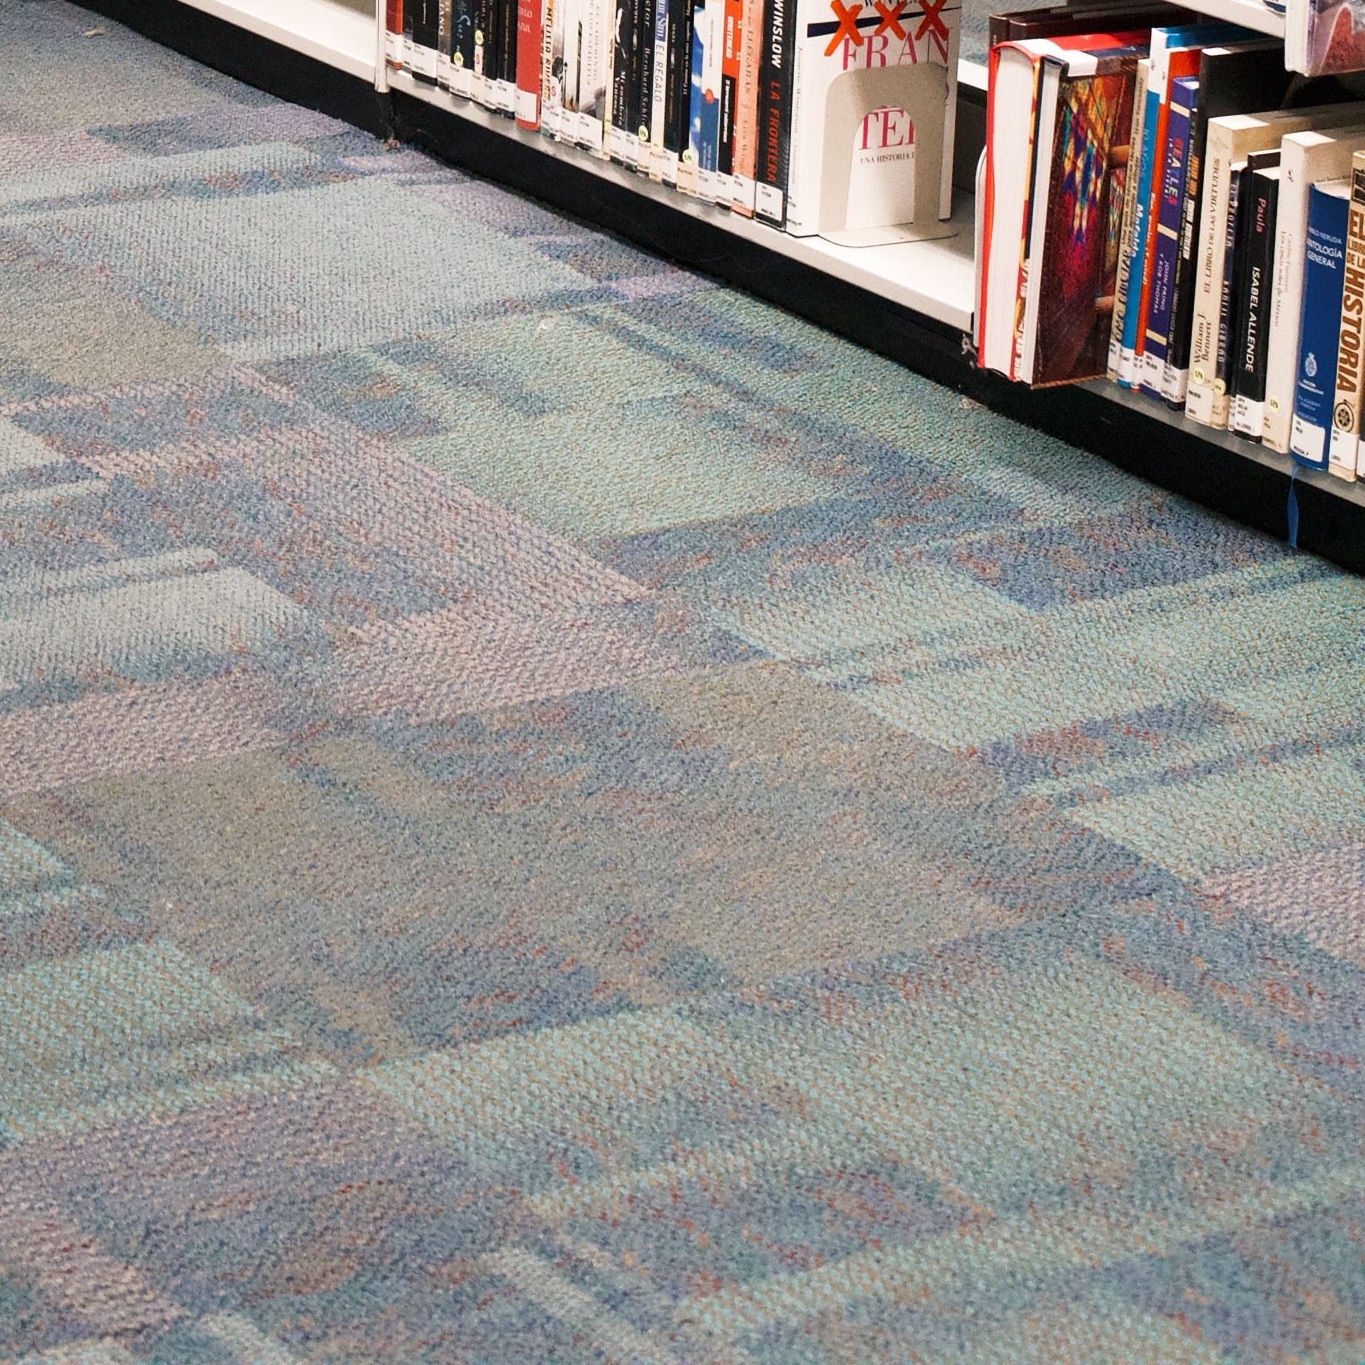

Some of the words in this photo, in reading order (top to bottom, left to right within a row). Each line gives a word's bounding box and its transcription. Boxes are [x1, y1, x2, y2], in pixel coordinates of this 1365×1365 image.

[655, 44, 665, 57] EL
[654, 59, 664, 103] REGALO
[770, 81, 780, 99] LA
[766, 107, 780, 183] FRONTERA
[875, 152, 911, 164] HISTORIA
[1167, 137, 1183, 205] BEATLES
[1209, 158, 1220, 215] VIRTUDES
[1130, 203, 1144, 258] Mafalda
[1255, 197, 1267, 233] Paula
[1249, 266, 1261, 308] ISABEL
[1194, 324, 1204, 364] William
[1202, 322, 1212, 361] Bennett
[1244, 311, 1259, 373] ALLENDE
[1336, 269, 1364, 392] HISTORIA
